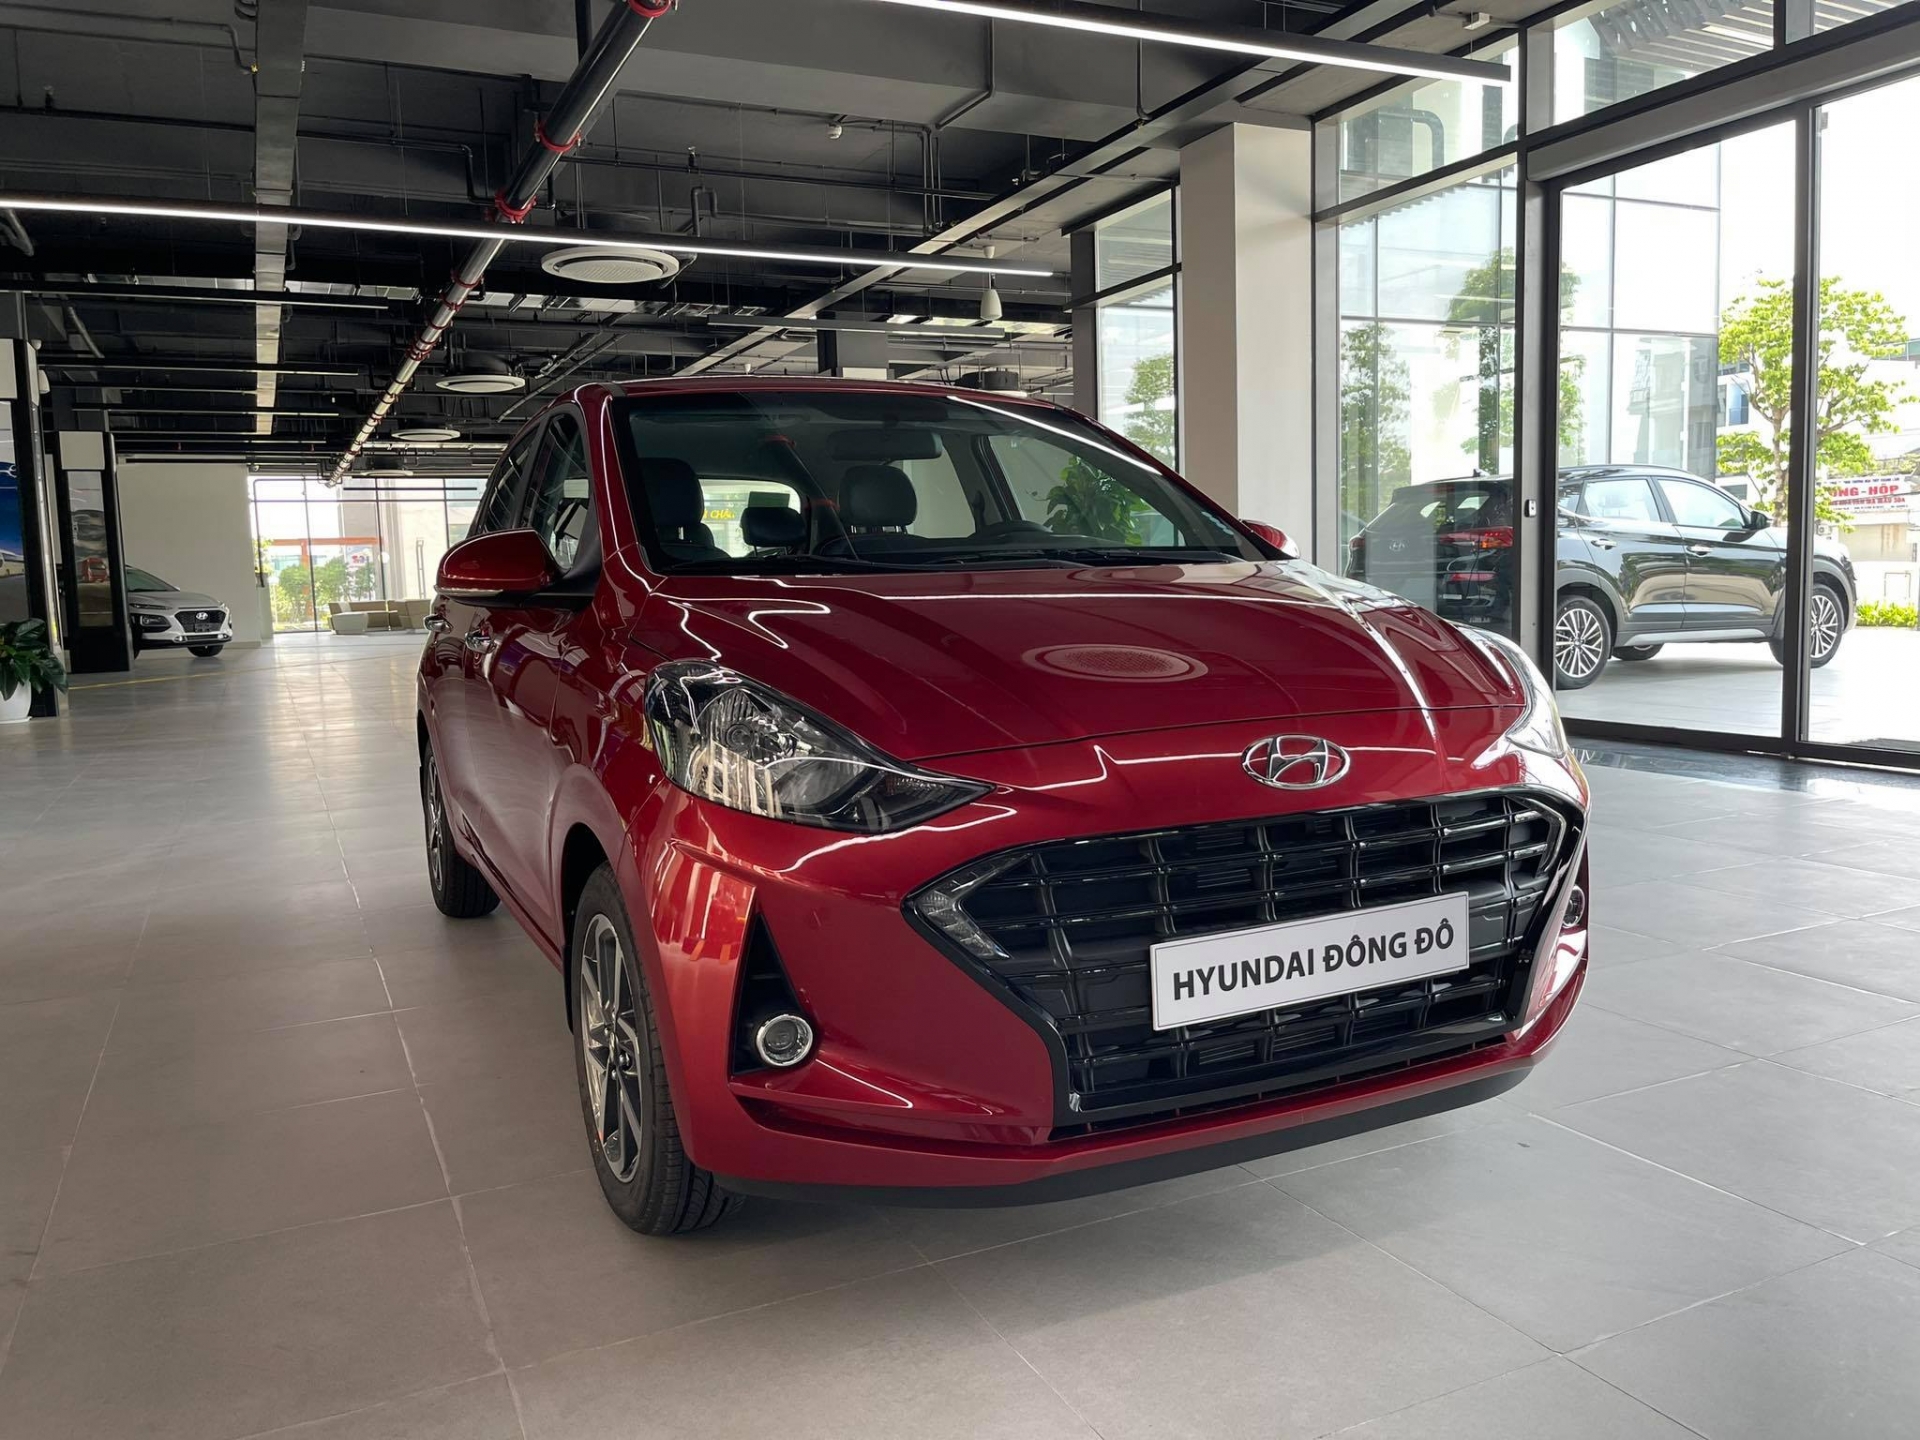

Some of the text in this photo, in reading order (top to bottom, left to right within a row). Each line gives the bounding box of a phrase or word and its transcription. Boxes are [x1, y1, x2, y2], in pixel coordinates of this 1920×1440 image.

[1173, 917, 1455, 1001] HYUNDAI ĐÔNG ĐÔ
